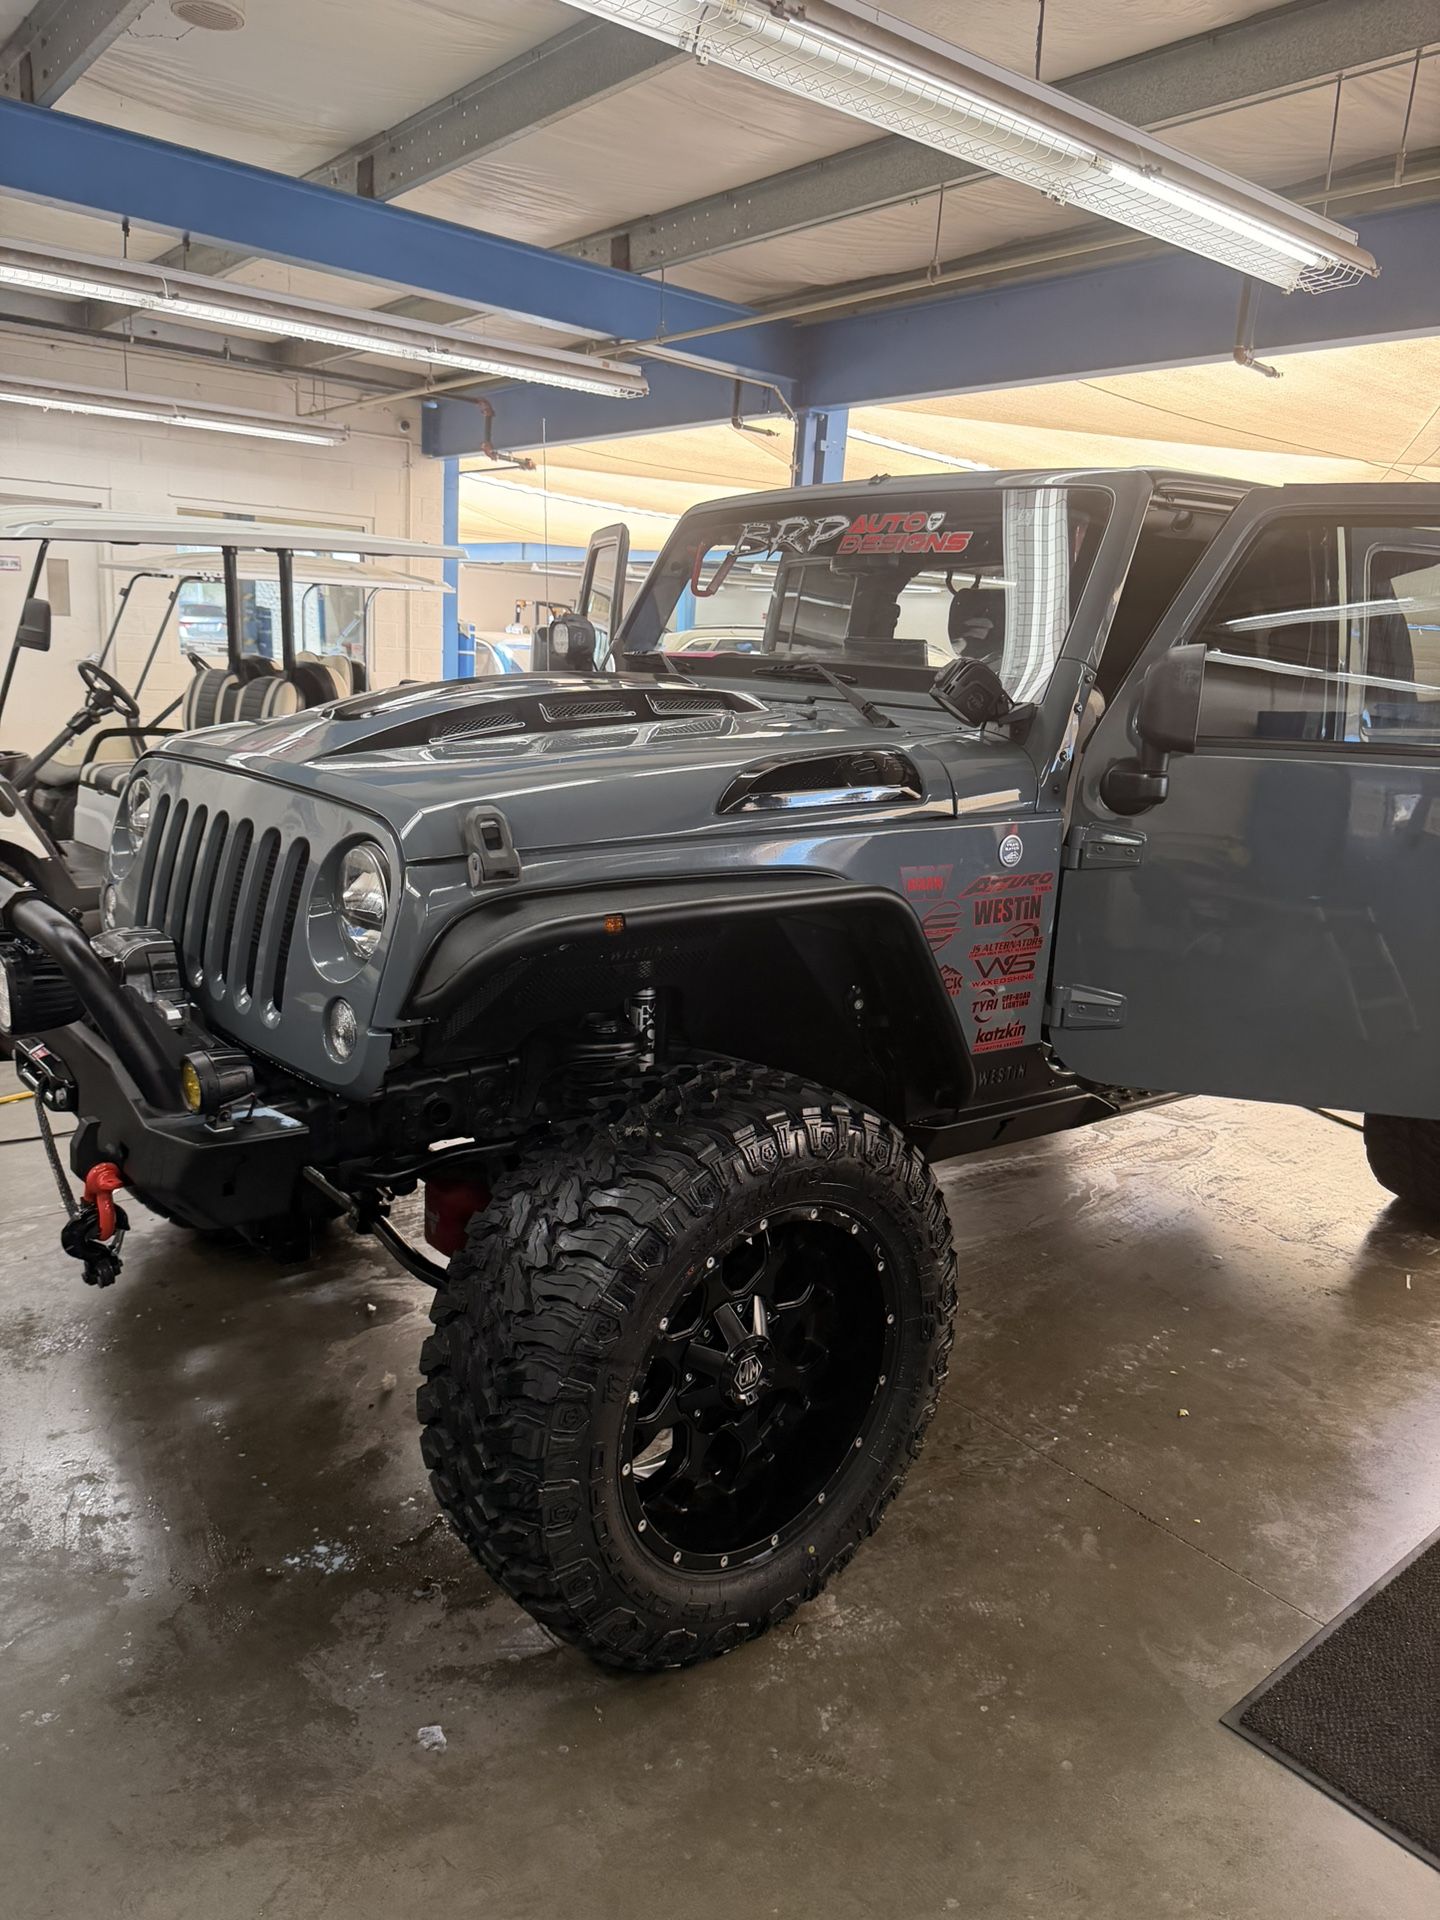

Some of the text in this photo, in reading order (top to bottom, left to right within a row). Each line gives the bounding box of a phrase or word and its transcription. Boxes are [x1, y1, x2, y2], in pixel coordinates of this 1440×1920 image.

[848, 512, 928, 534] AUTO
[733, 515, 850, 559] BRP
[836, 531, 974, 555] DESIGNS
[982, 937, 1043, 952] ALTERNATORS
[972, 998, 998, 1013] TYRI
[975, 1019, 1026, 1044] katzkin
